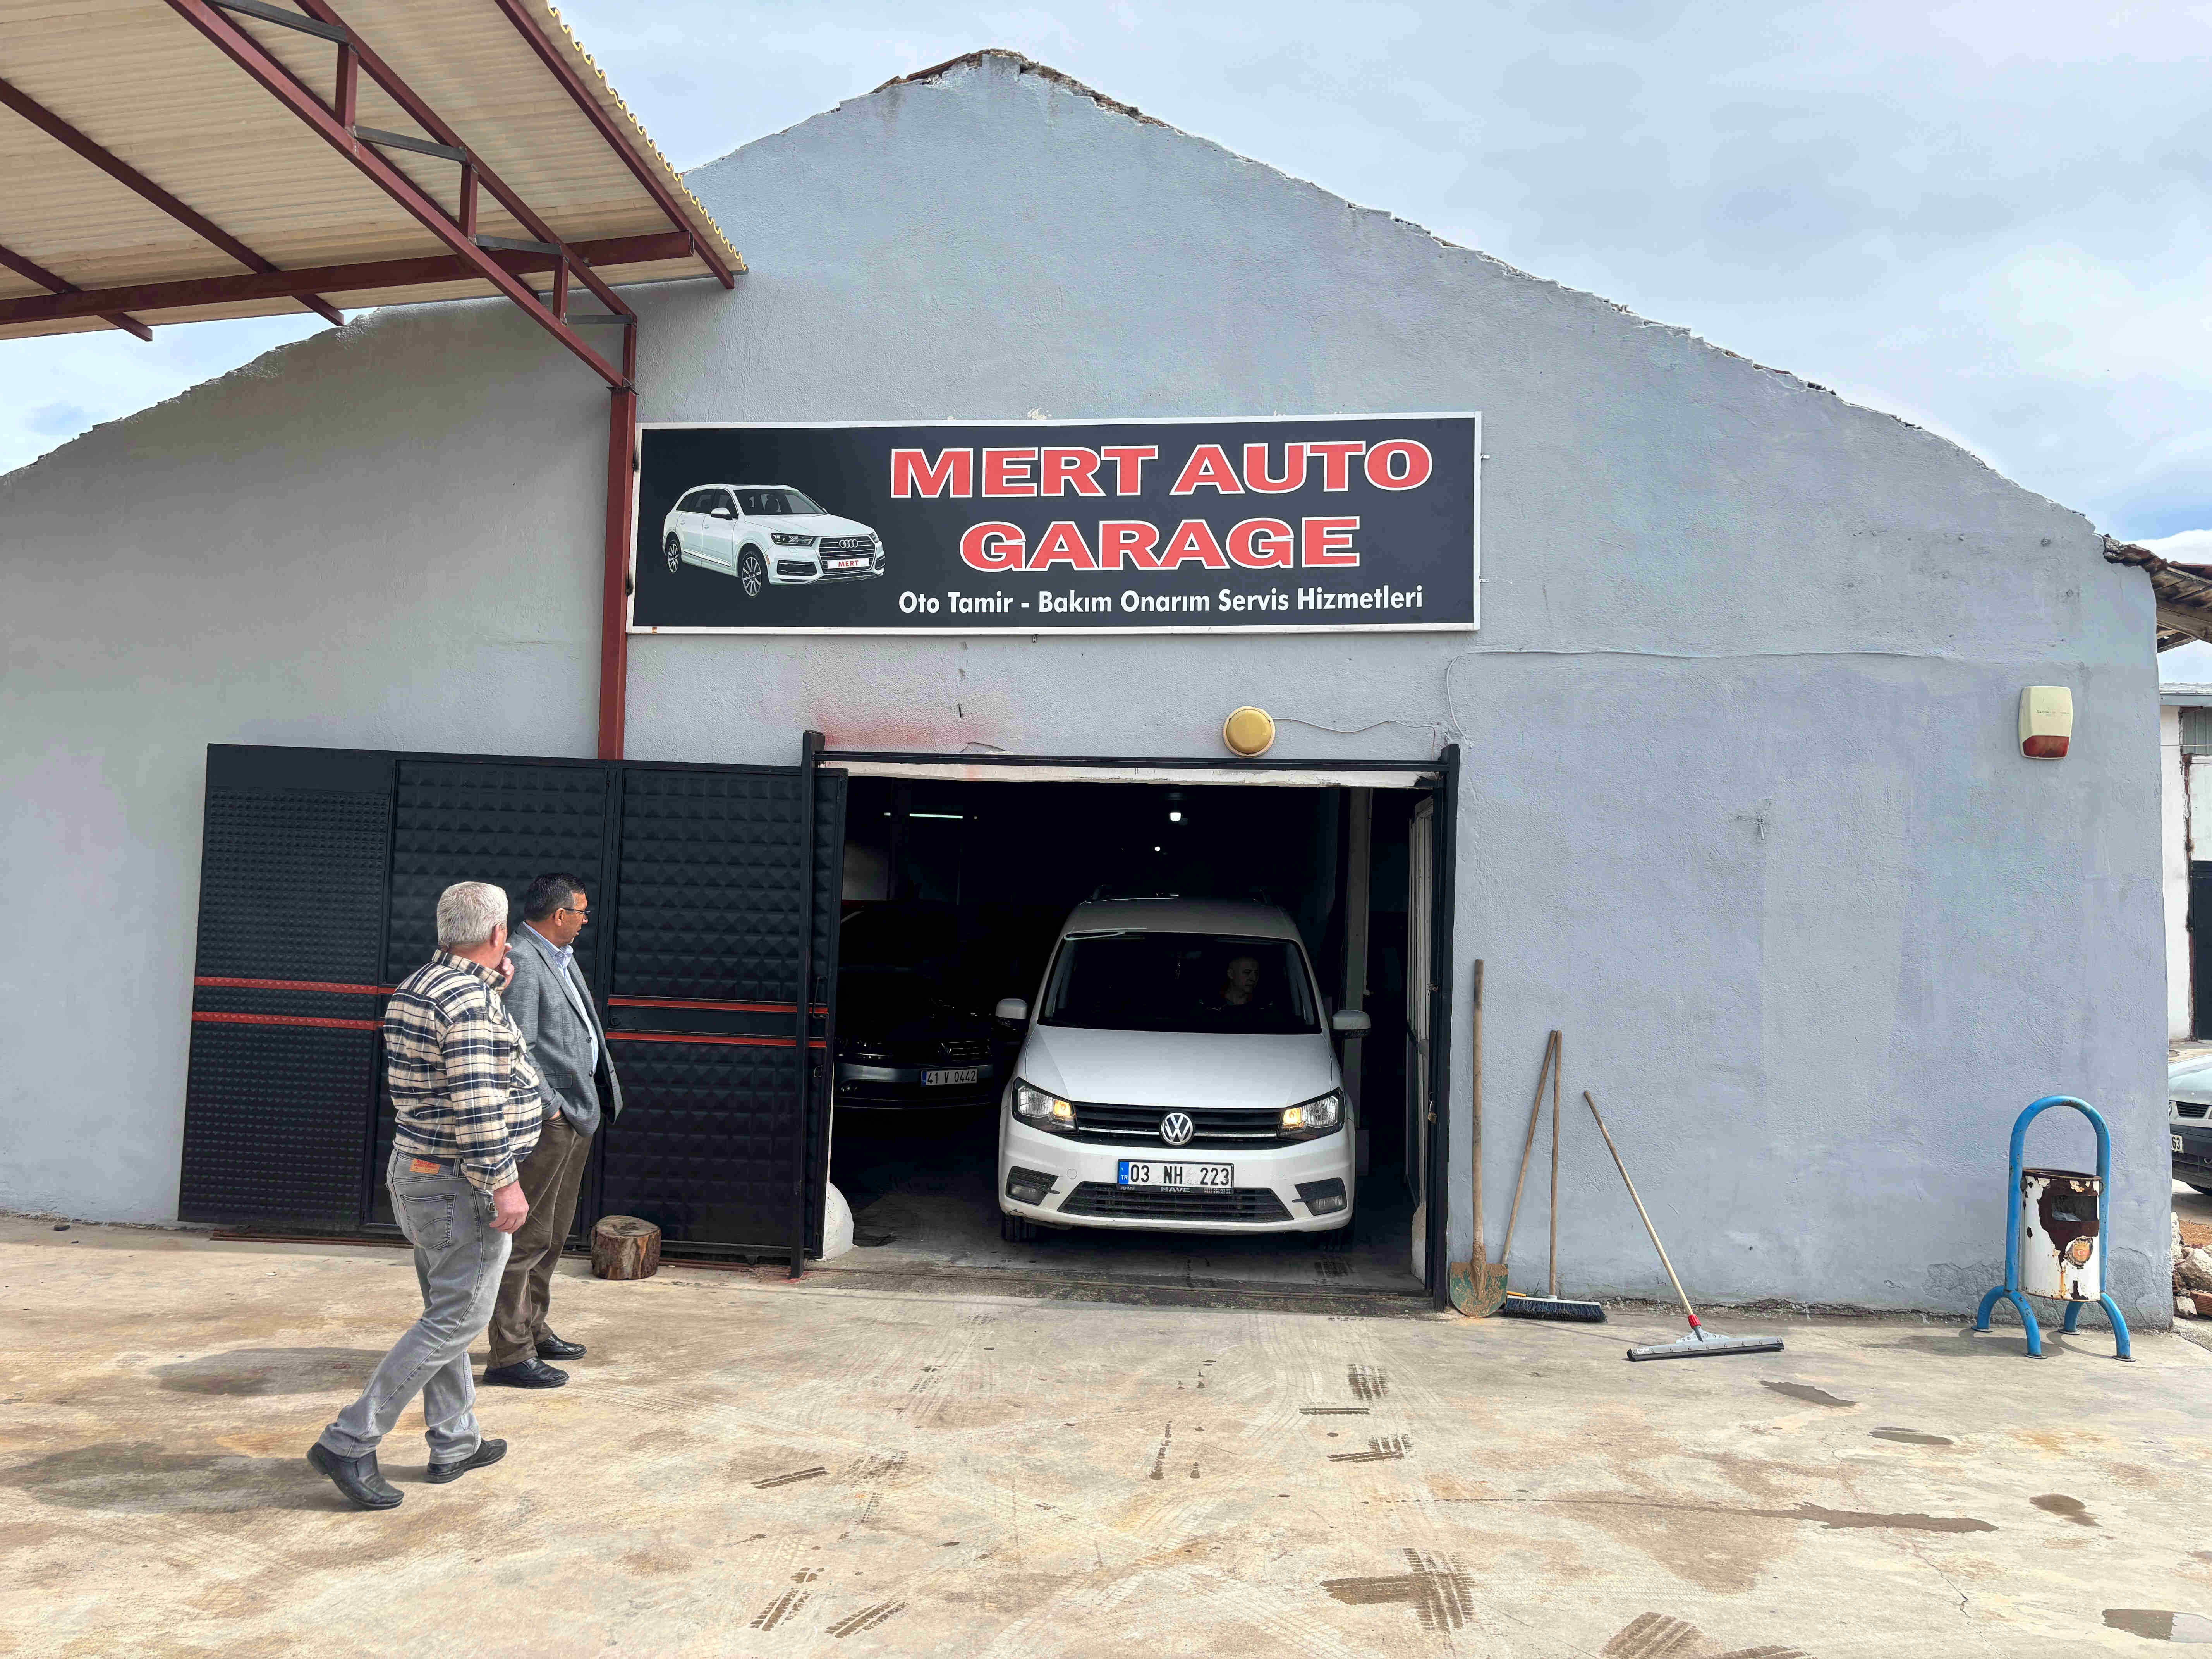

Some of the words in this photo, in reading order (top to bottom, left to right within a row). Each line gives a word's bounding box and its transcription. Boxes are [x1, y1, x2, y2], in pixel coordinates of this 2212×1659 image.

[891, 445, 1158, 498] MERT
[1169, 439, 1432, 495] AUTO
[960, 516, 1360, 572] GARAGE
[899, 591, 940, 613] Oto
[948, 591, 1013, 613] Tamir
[1039, 590, 1112, 613] Bakım
[1121, 590, 1210, 612] Onarım
[1218, 587, 1289, 611] Servis
[1298, 585, 1422, 610] Hizmetleri
[927, 1072, 938, 1084] 41
[945, 1072, 949, 1083] V
[955, 1070, 976, 1082] 0442
[2171, 1136, 2180, 1150] 63
[1131, 1164, 1150, 1183] 03
[1164, 1166, 1183, 1184] NH
[1200, 1167, 1229, 1186] 223
